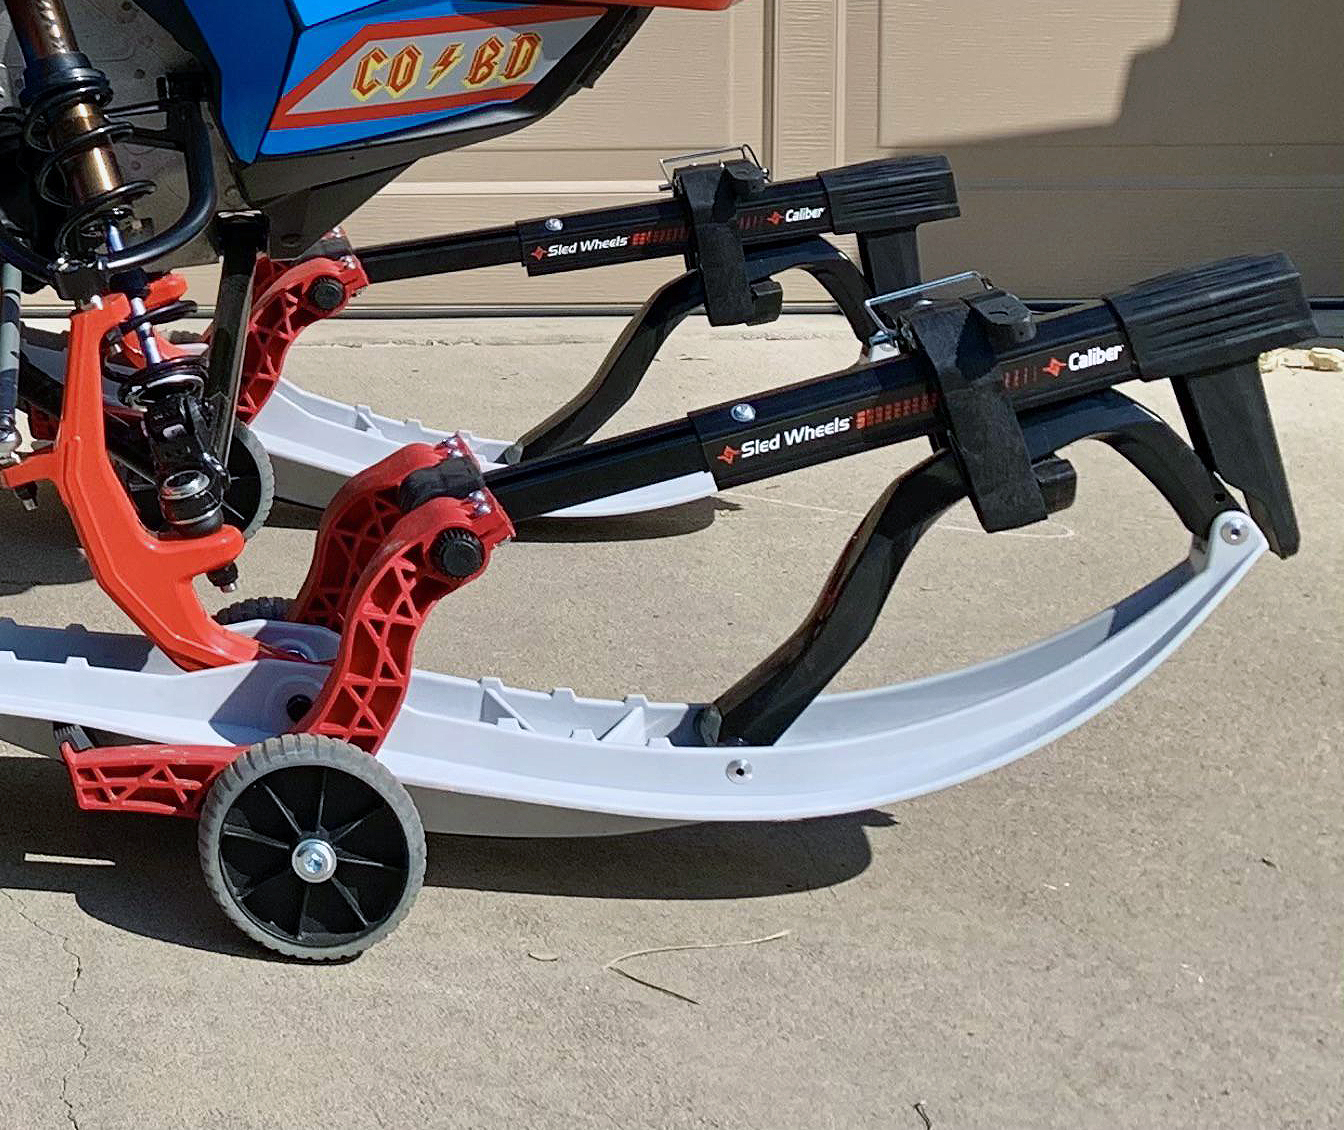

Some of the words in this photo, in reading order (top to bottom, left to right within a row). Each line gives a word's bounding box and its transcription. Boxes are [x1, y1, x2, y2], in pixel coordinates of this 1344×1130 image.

[785, 207, 823, 222] Caliber
[547, 242, 577, 257] Sled
[579, 236, 628, 252] Wheels
[1068, 345, 1122, 372] Caliber
[741, 434, 781, 459] Sled
[783, 416, 851, 447] Wheels
